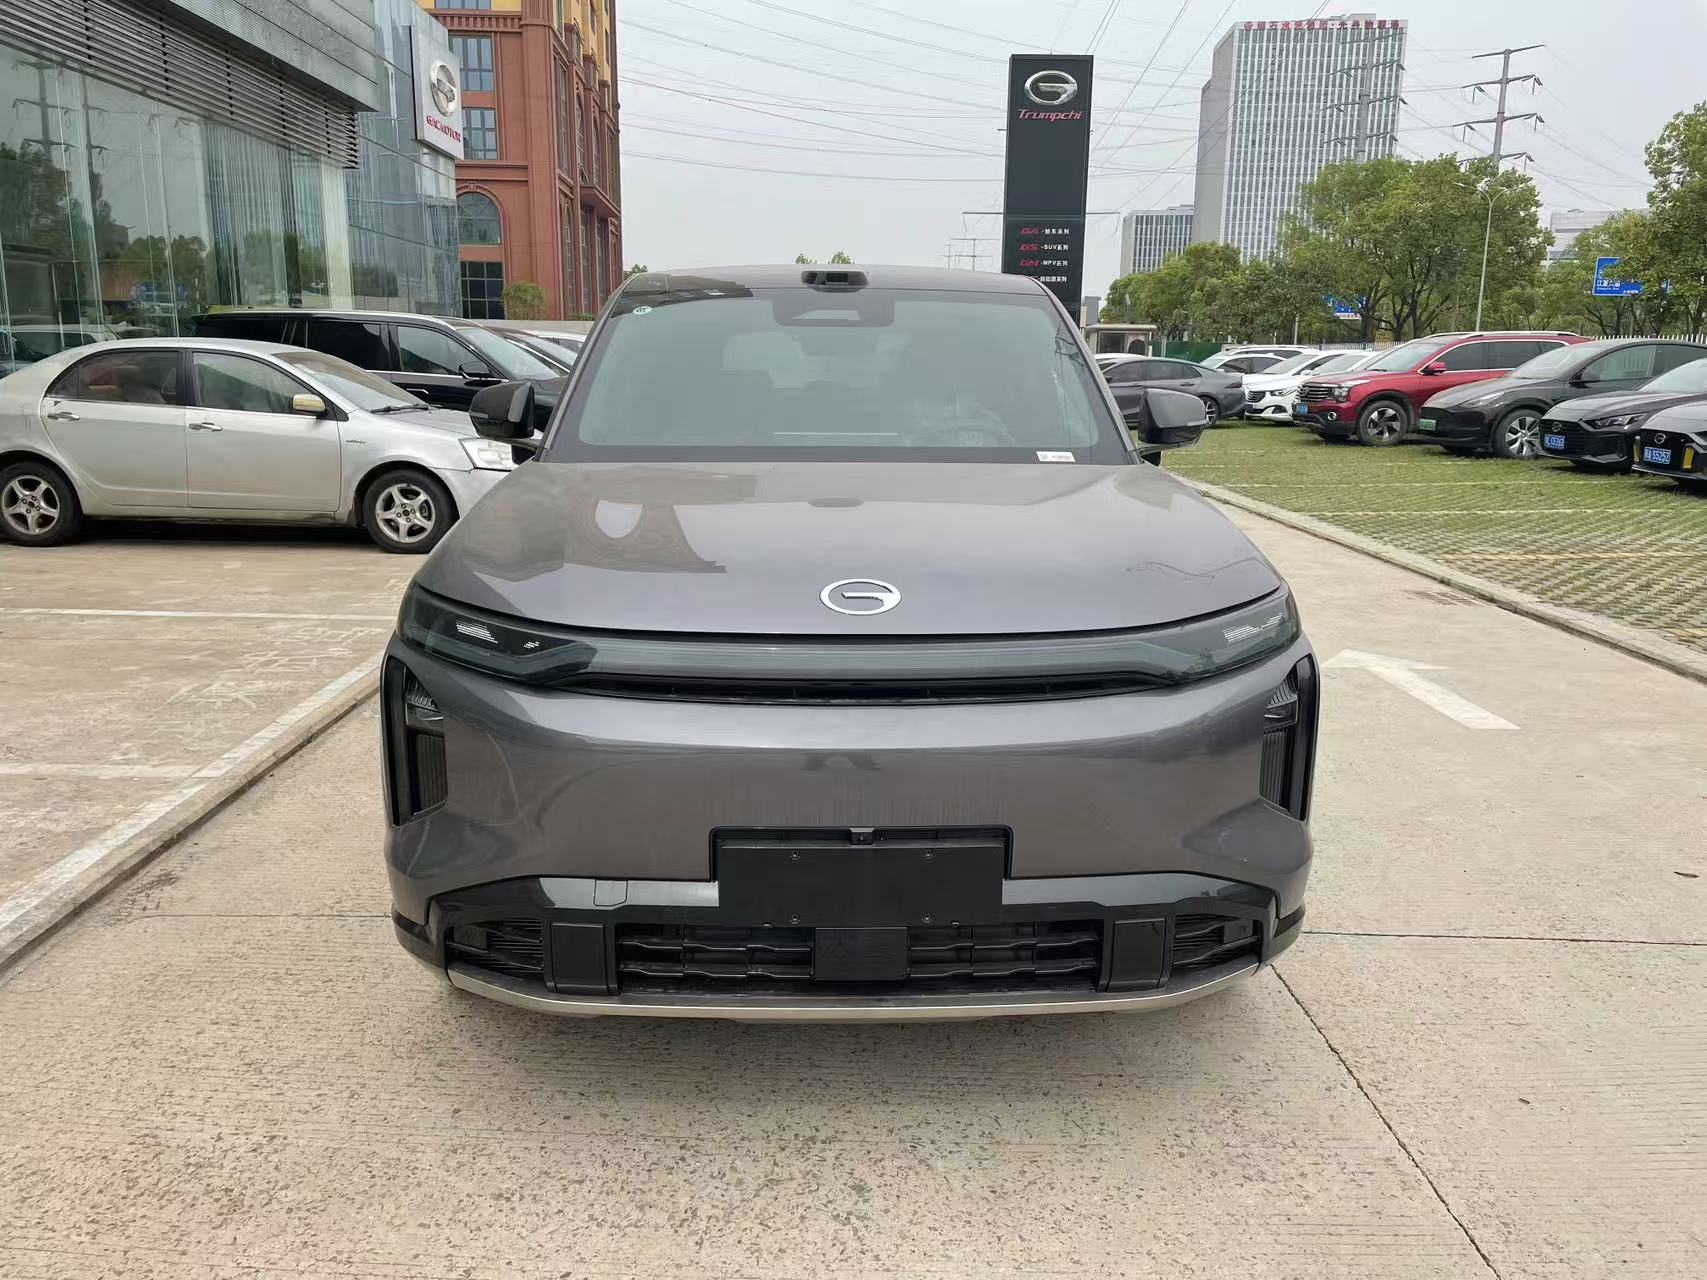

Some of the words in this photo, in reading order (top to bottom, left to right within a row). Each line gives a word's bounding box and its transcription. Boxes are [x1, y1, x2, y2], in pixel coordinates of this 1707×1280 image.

[1018, 109, 1083, 122] Trumpchi
[426, 115, 441, 130] GAC
[441, 122, 461, 142] MOTOR
